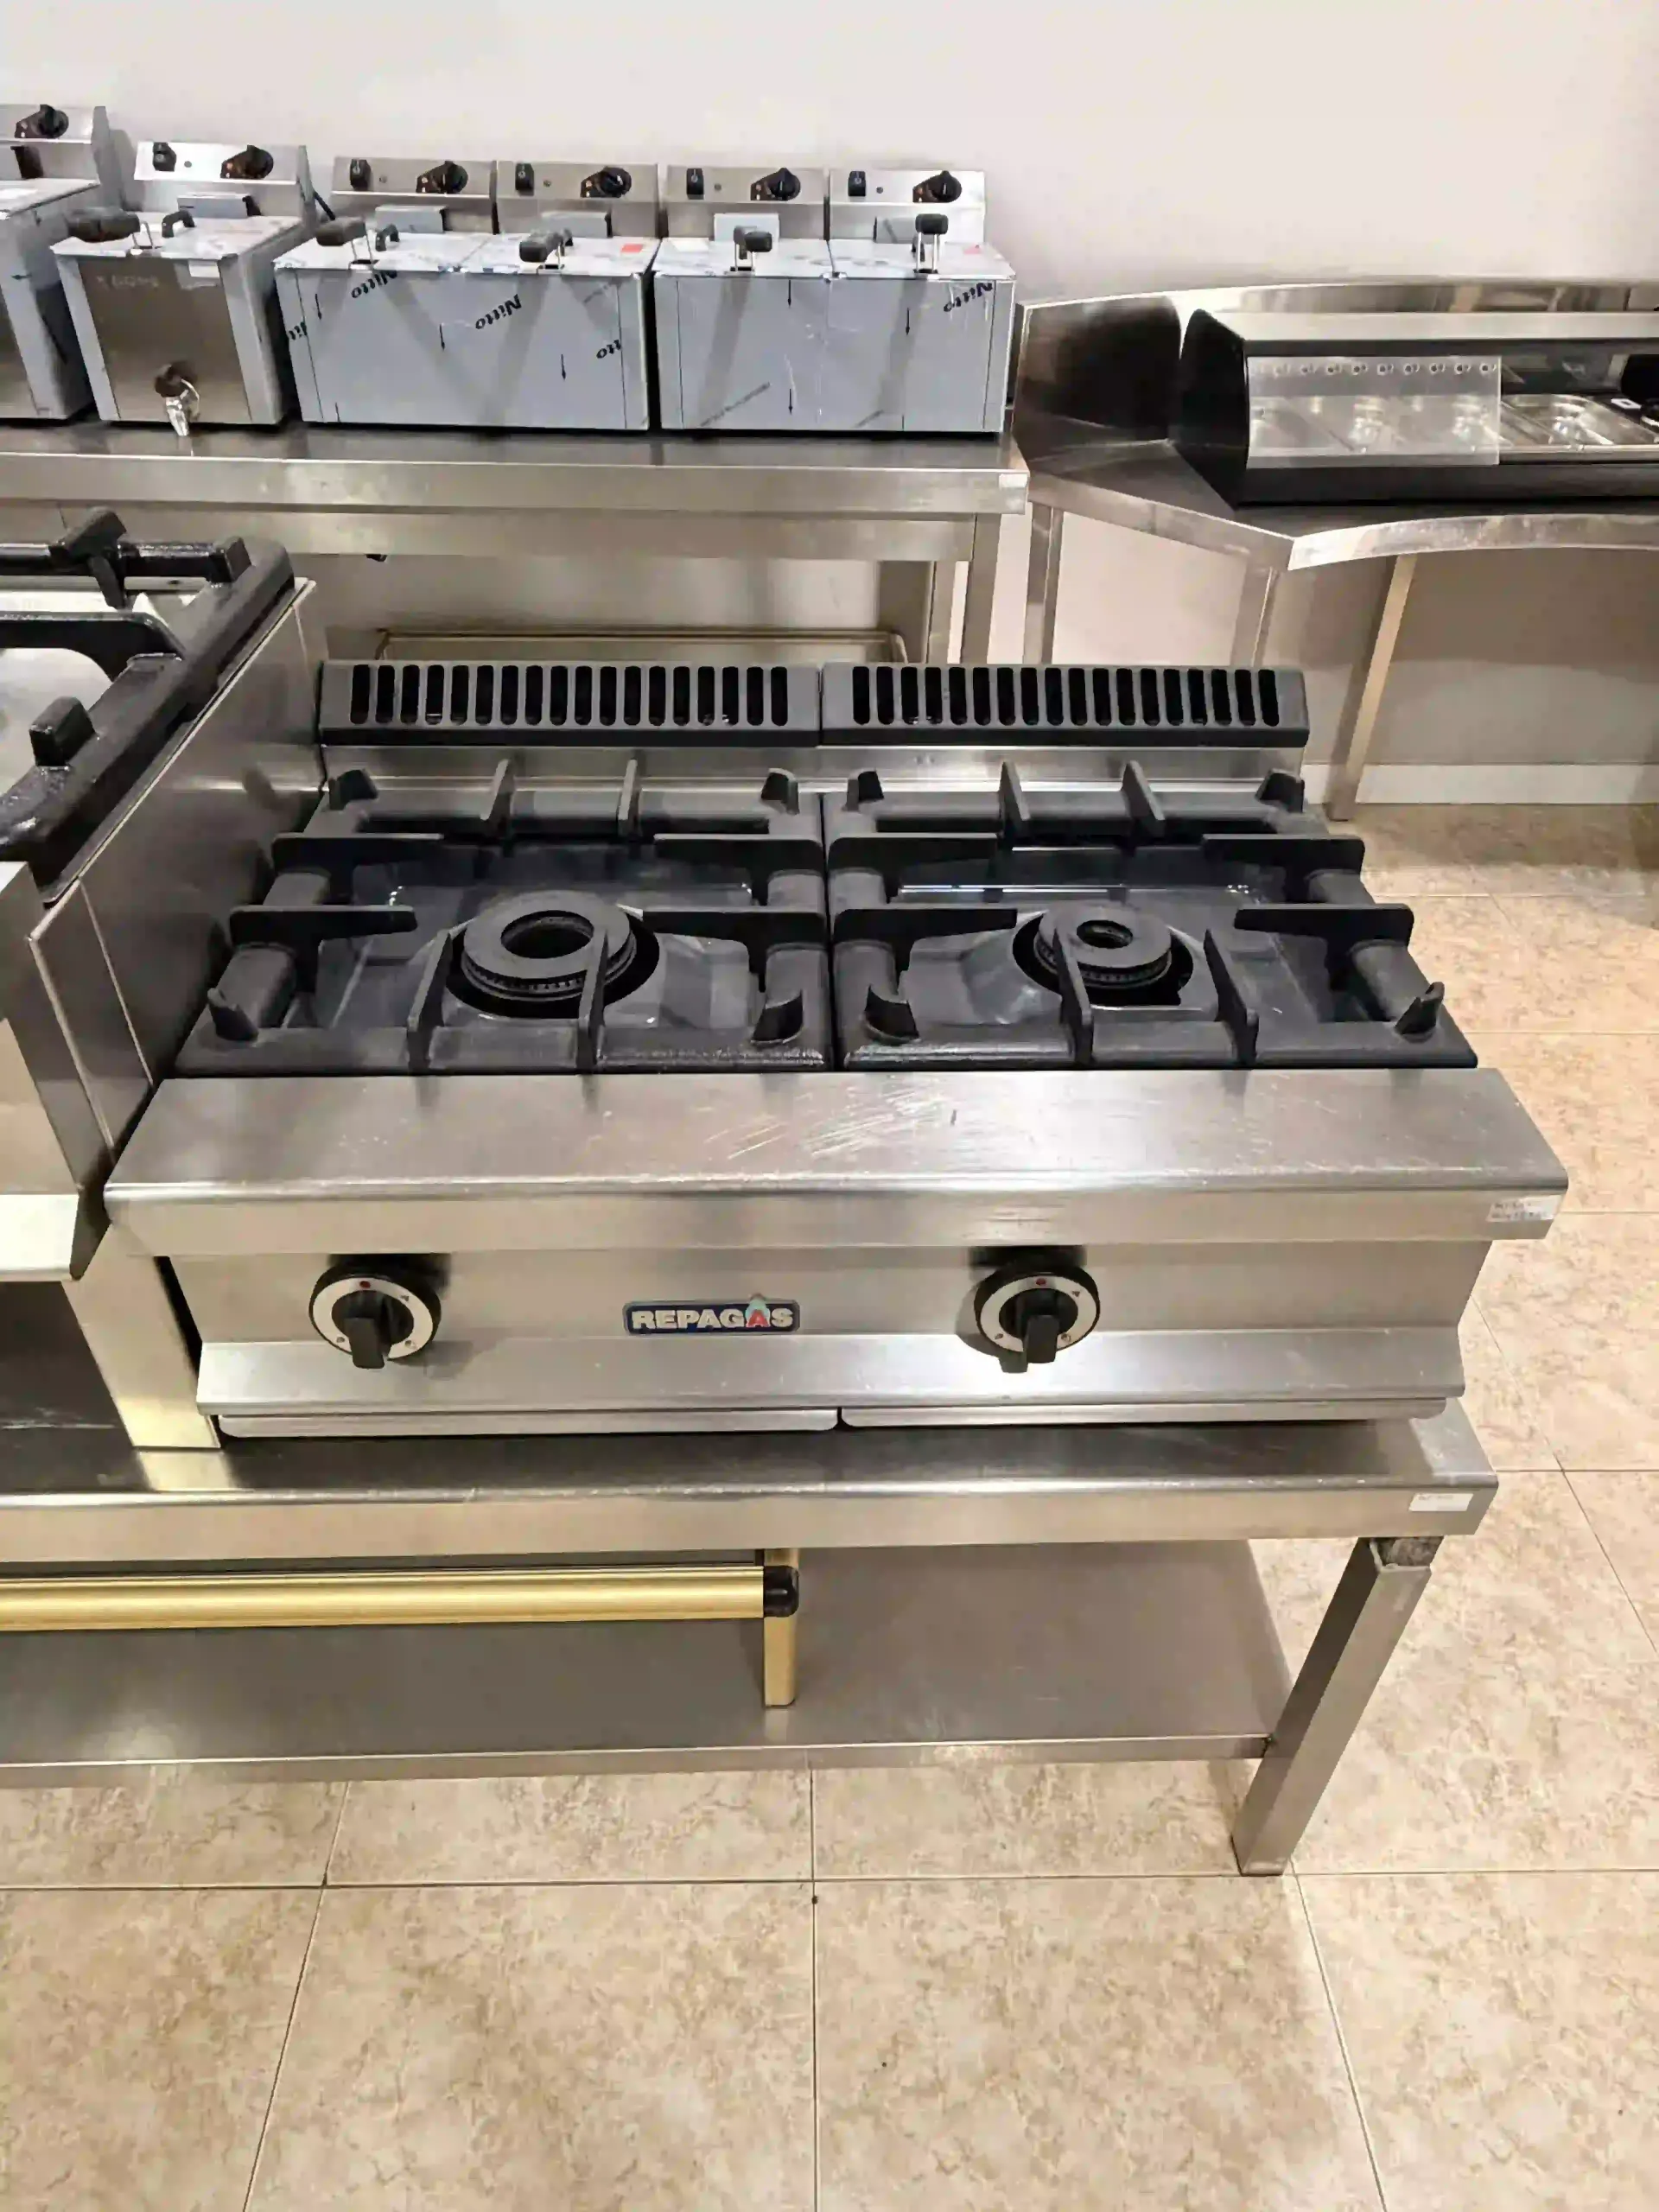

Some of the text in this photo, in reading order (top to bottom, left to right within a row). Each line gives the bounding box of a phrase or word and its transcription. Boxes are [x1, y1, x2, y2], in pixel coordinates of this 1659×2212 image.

[475, 294, 522, 329] Nitto
[944, 283, 993, 312] Nitto
[632, 1307, 793, 1329] REPAGAS
